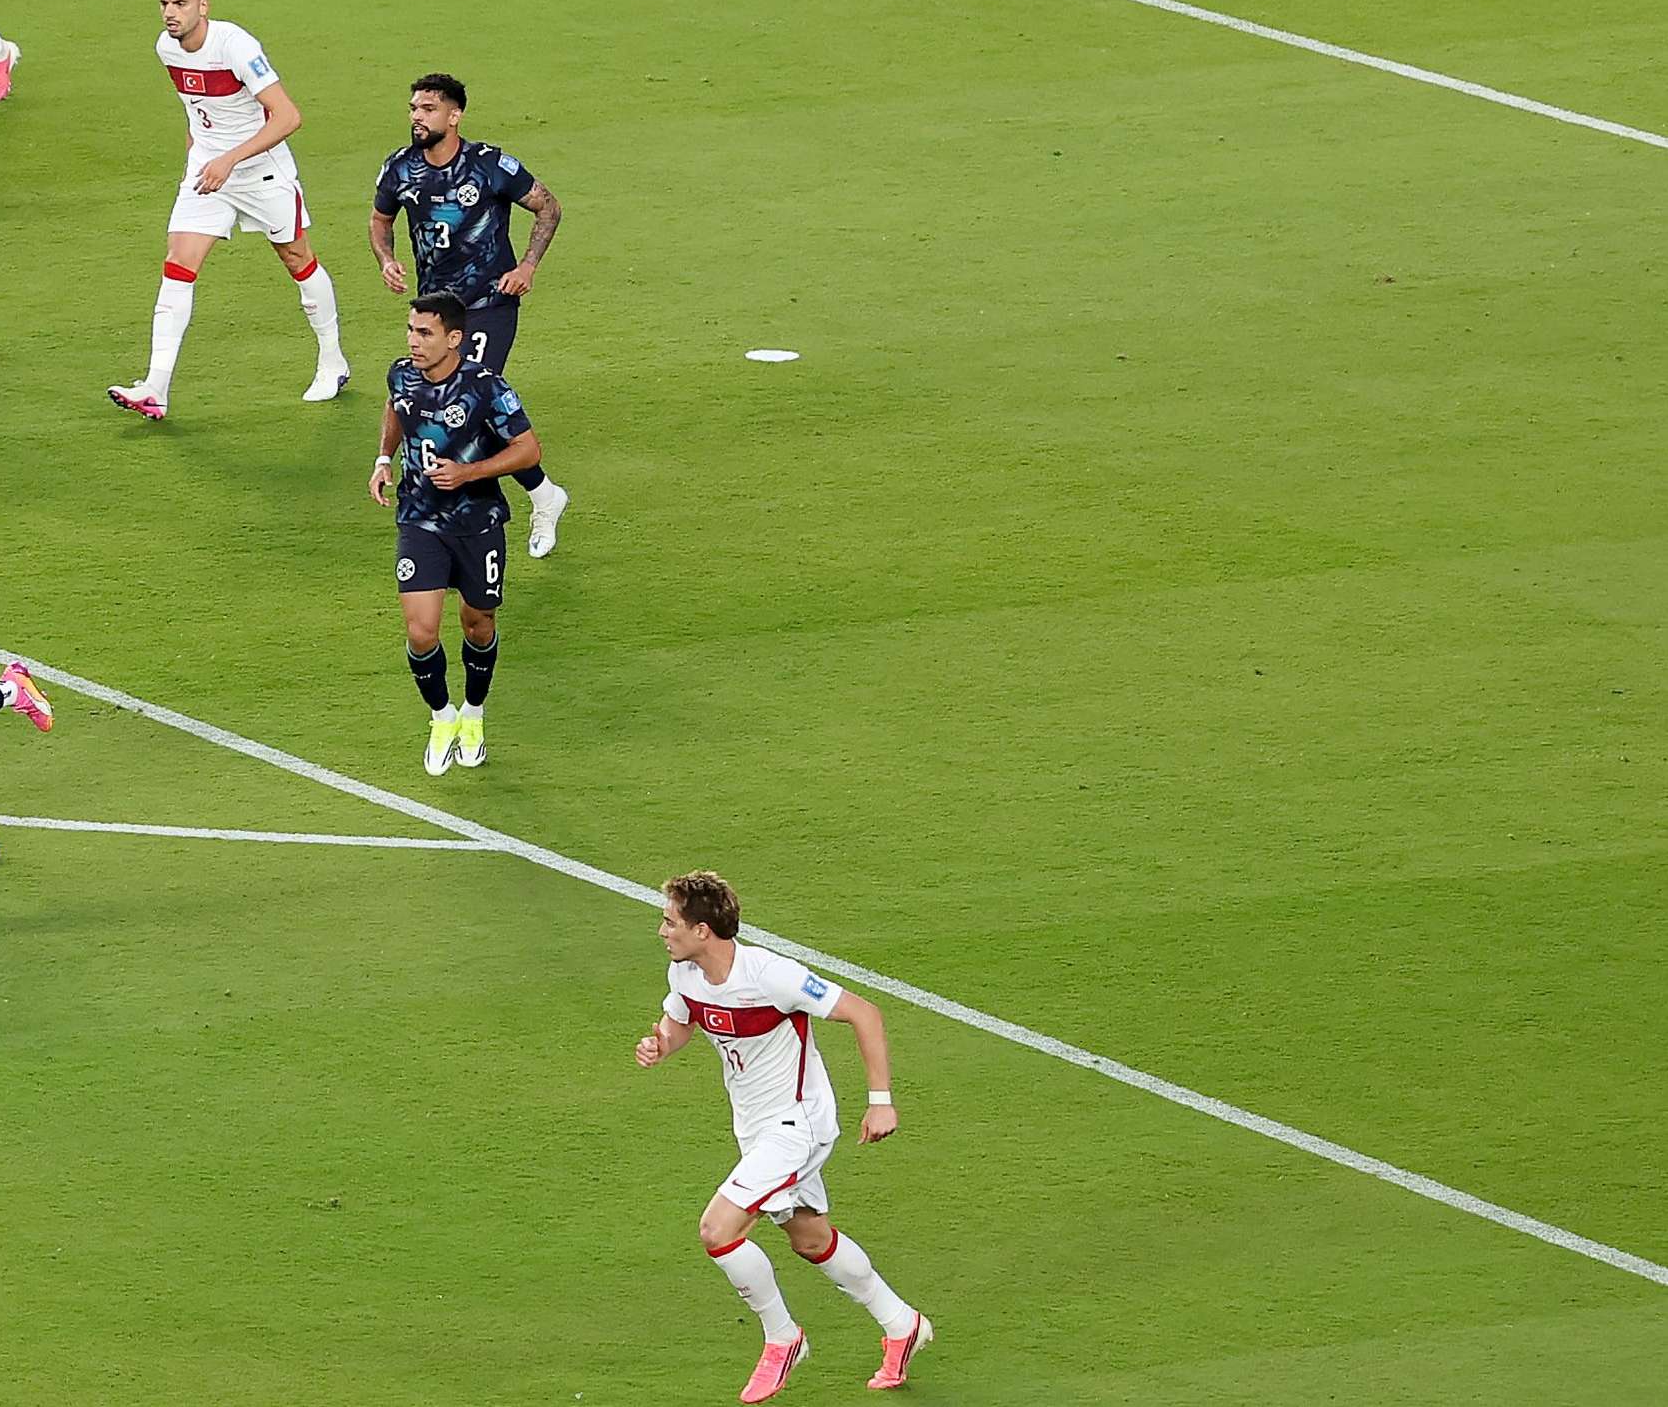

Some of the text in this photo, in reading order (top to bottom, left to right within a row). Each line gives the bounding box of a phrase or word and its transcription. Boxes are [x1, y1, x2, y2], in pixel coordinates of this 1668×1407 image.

[197, 107, 212, 130] 3
[434, 221, 451, 249] 3
[466, 331, 488, 364] 3
[421, 438, 439, 472] 6
[485, 549, 499, 584] 6
